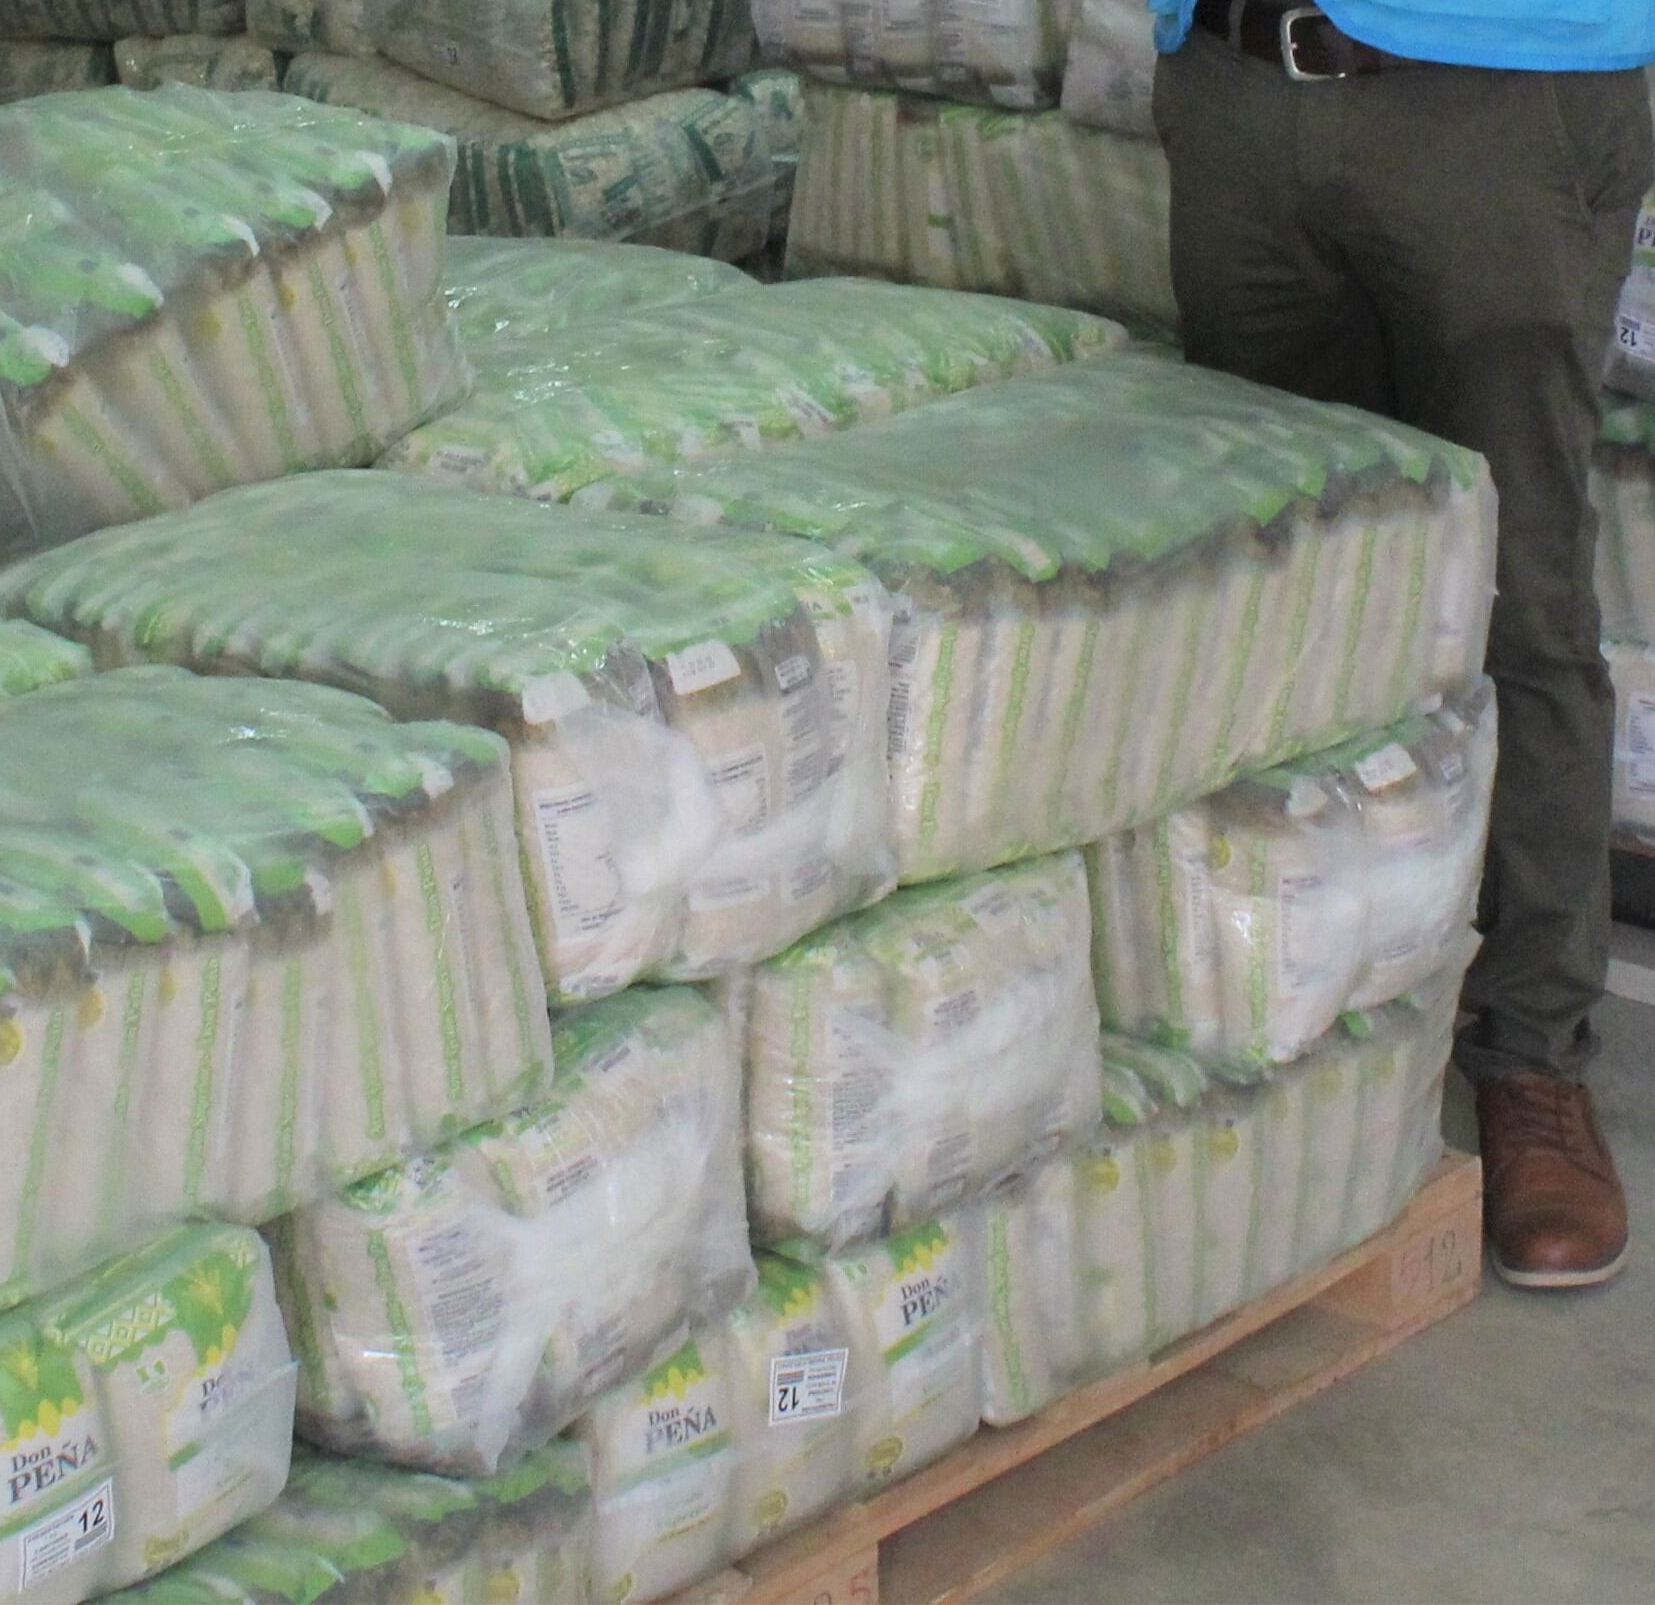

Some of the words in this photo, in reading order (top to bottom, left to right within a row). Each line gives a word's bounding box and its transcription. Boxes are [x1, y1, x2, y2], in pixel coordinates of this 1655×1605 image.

[1619, 325, 1639, 347] 12
[900, 1275, 952, 1326] PEÑ
[901, 1278, 931, 1299] Don
[777, 1386, 801, 1413] 12
[647, 1405, 718, 1454] PEÑA
[648, 1405, 681, 1427] Don
[8, 1434, 99, 1504] PEÑA
[11, 1446, 52, 1474] Don
[78, 1498, 105, 1534] 12
